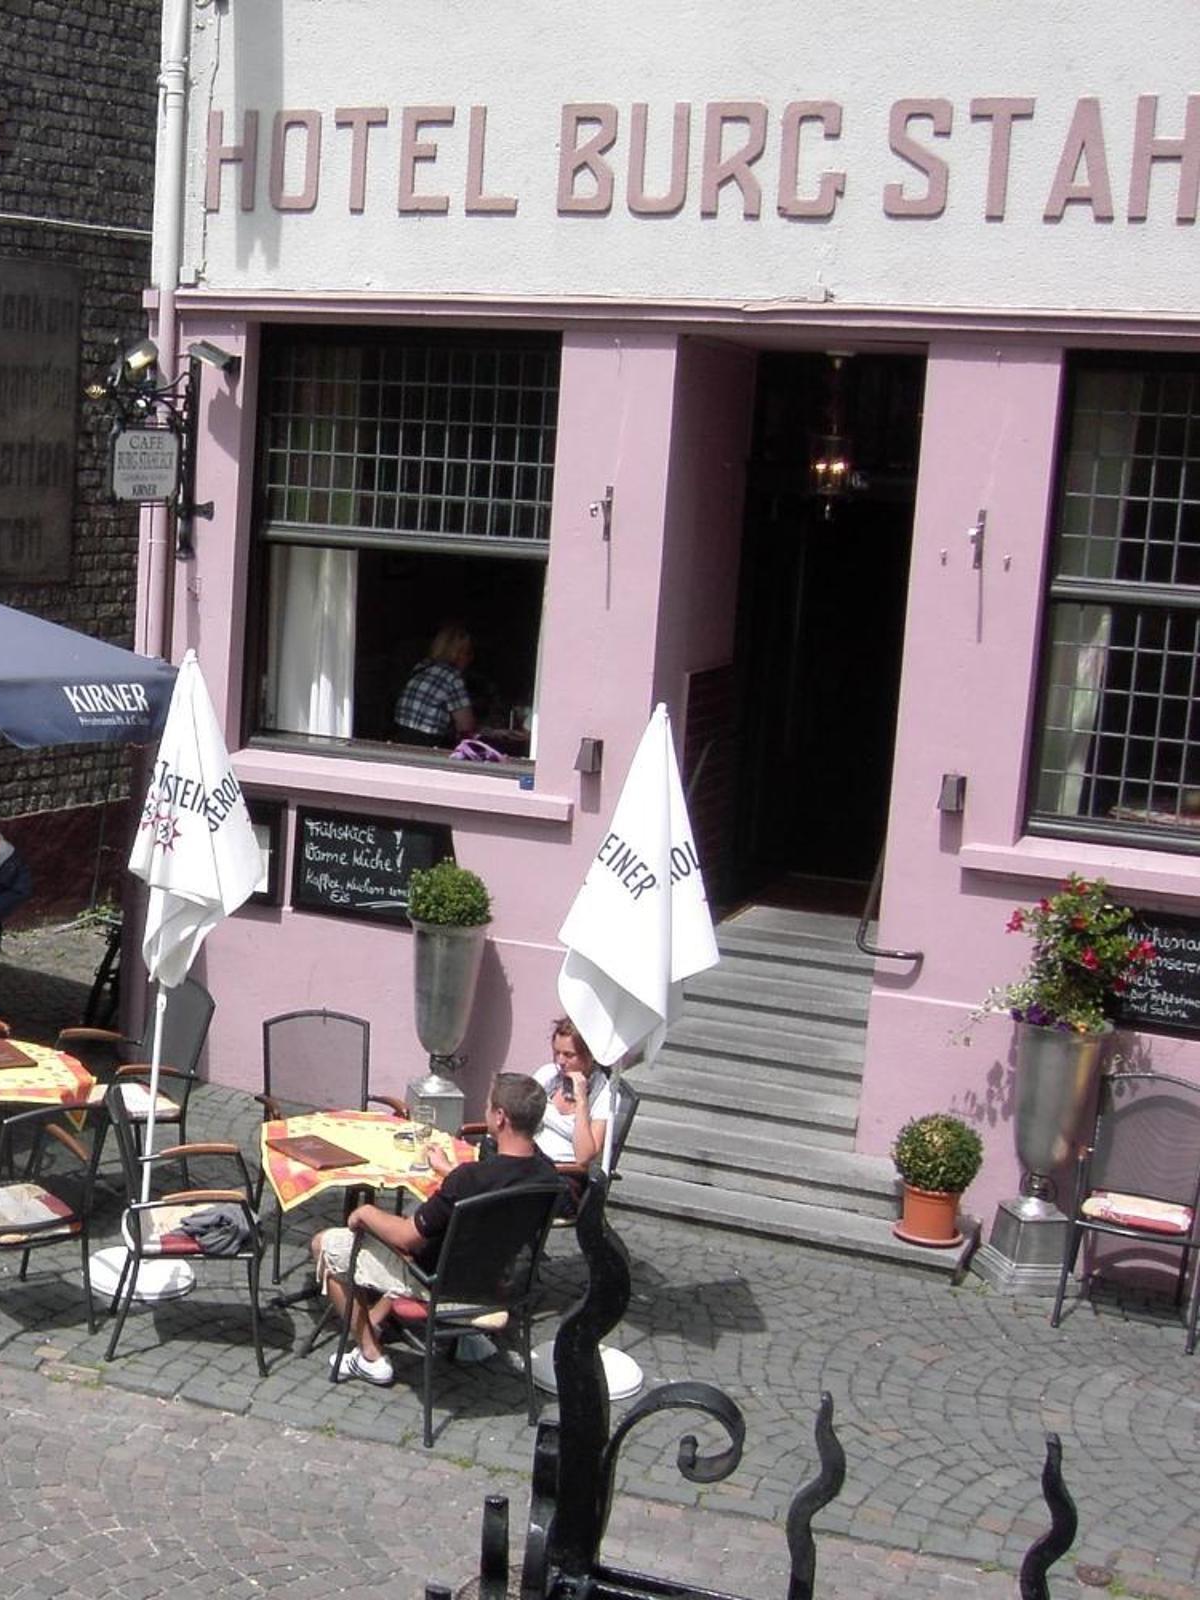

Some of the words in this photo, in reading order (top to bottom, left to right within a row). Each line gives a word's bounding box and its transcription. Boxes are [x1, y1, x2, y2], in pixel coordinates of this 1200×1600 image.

[206, 104, 517, 216] HOTEL
[63, 682, 151, 715] KIRNER
[598, 832, 657, 901] EINER
